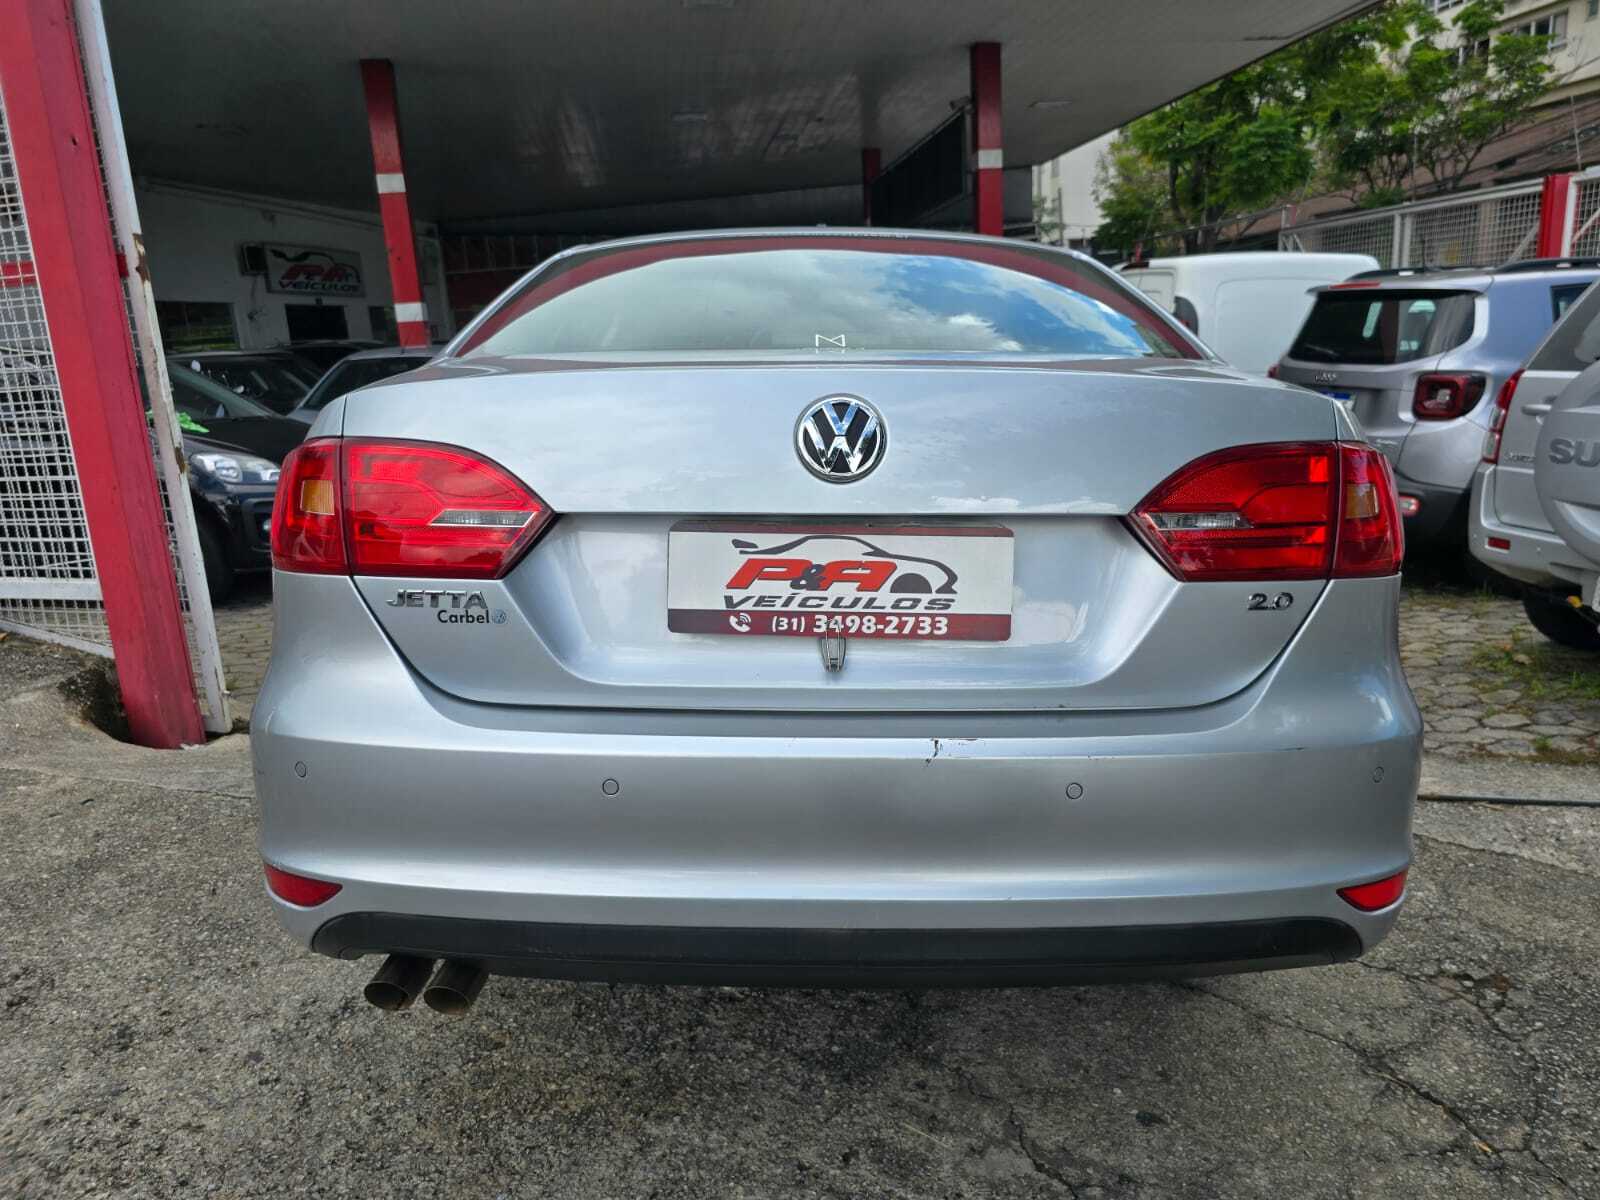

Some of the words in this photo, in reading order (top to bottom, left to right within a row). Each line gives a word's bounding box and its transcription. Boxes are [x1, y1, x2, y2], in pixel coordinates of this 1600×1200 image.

[726, 558, 898, 592] P&A
[386, 588, 488, 609] JETTA
[723, 593, 956, 611] VEÍCULOS
[1247, 592, 1294, 611] 2.0
[437, 610, 489, 624] Carbel
[771, 615, 806, 633] (31)
[813, 614, 949, 635] 3498-2733
